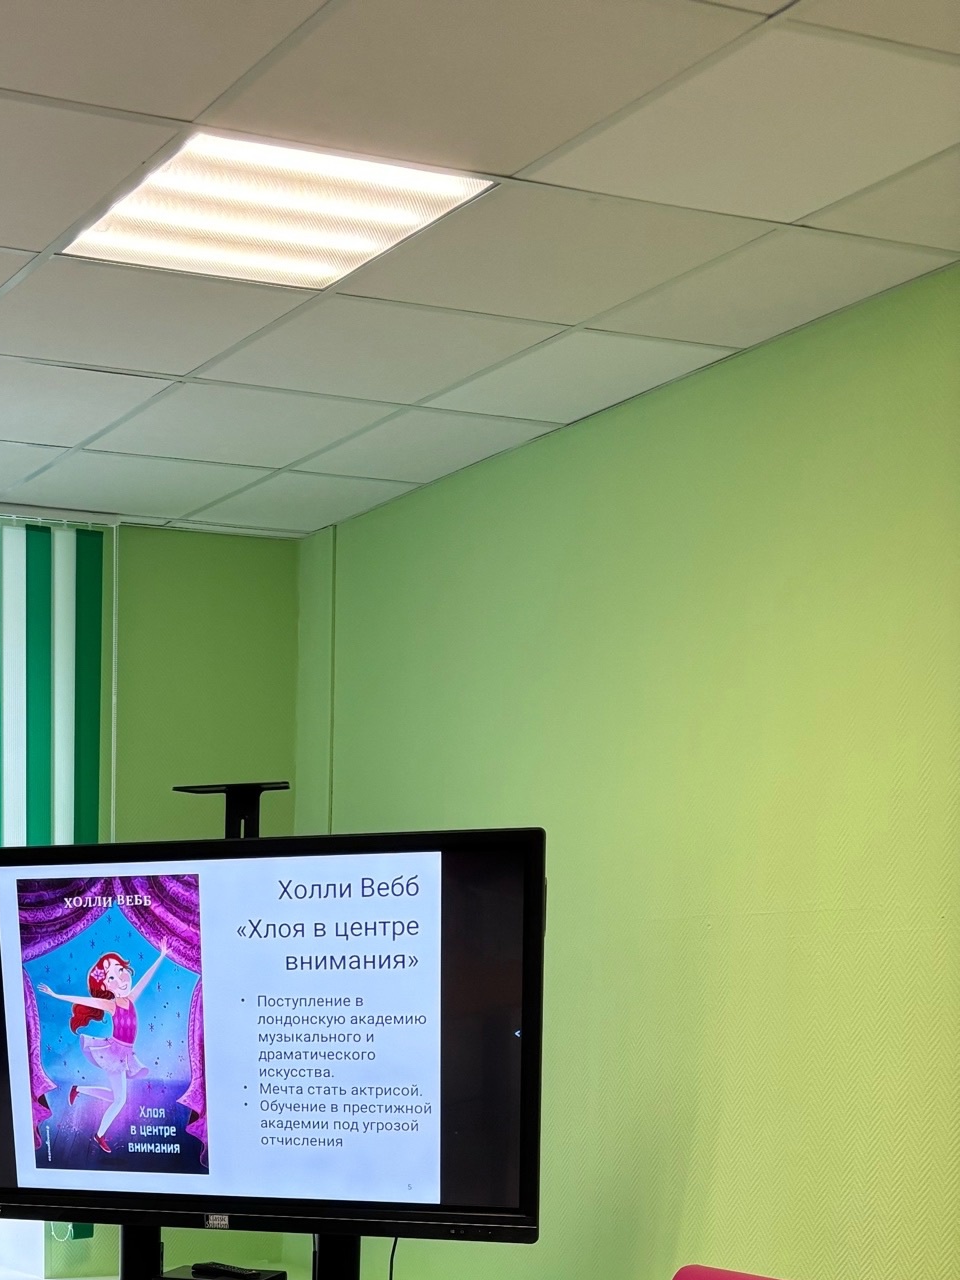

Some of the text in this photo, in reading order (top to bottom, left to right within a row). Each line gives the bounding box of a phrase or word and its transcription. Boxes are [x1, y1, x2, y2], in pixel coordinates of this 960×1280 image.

[278, 875, 419, 900] Холли Вебб
[64, 894, 152, 908] ХОЛЛИ ВЕББ
[237, 919, 419, 941] «Хлоя в центре
[286, 954, 419, 970] внимания»
[257, 995, 364, 1010] Поступление в
[257, 1015, 427, 1028] лондонскую академию
[258, 1033, 374, 1045] музыкального и
[258, 1050, 376, 1062] драматического
[259, 1067, 334, 1080] искусства.
[259, 1083, 423, 1099] Мечта стать актрисой.
[140, 1106, 165, 1118] Хлоя
[260, 1100, 432, 1115] Обучение в престижной
[130, 1125, 176, 1137] в центре
[260, 1119, 419, 1133] академии под угрозой
[128, 1142, 180, 1154] внимания
[261, 1136, 343, 1147] отчисления
